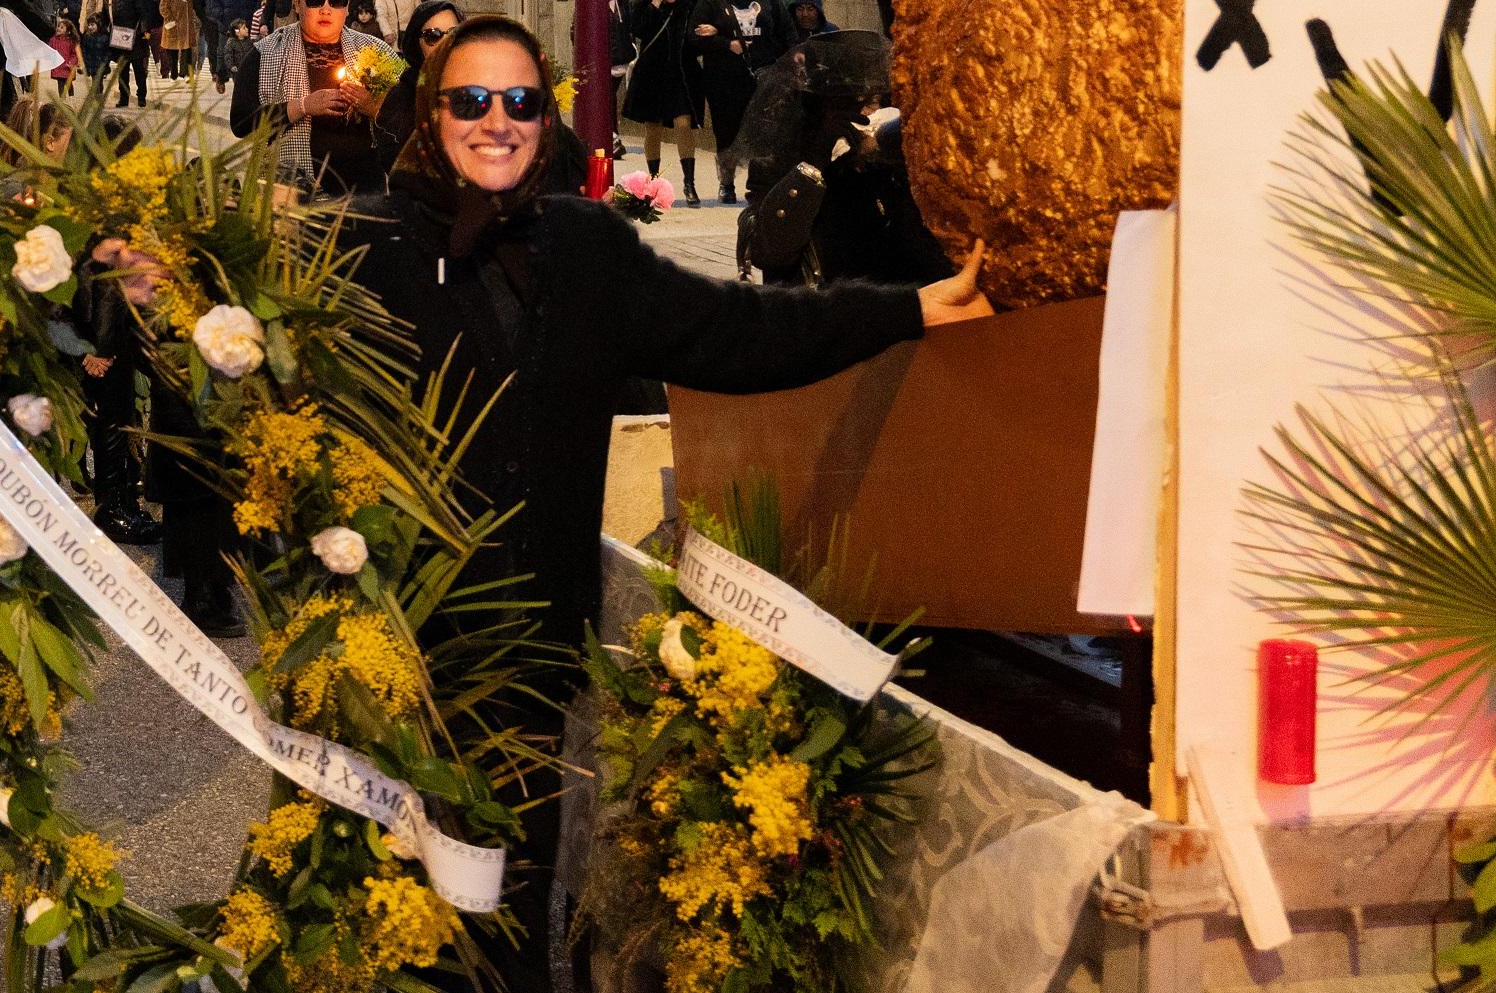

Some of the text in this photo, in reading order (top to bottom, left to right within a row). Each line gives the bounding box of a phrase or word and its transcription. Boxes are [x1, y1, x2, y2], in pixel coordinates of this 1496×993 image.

[53, 531, 146, 621] MORREU
[142, 616, 174, 650] DE
[174, 644, 249, 715] TANTO
[708, 572, 788, 633] FODER
